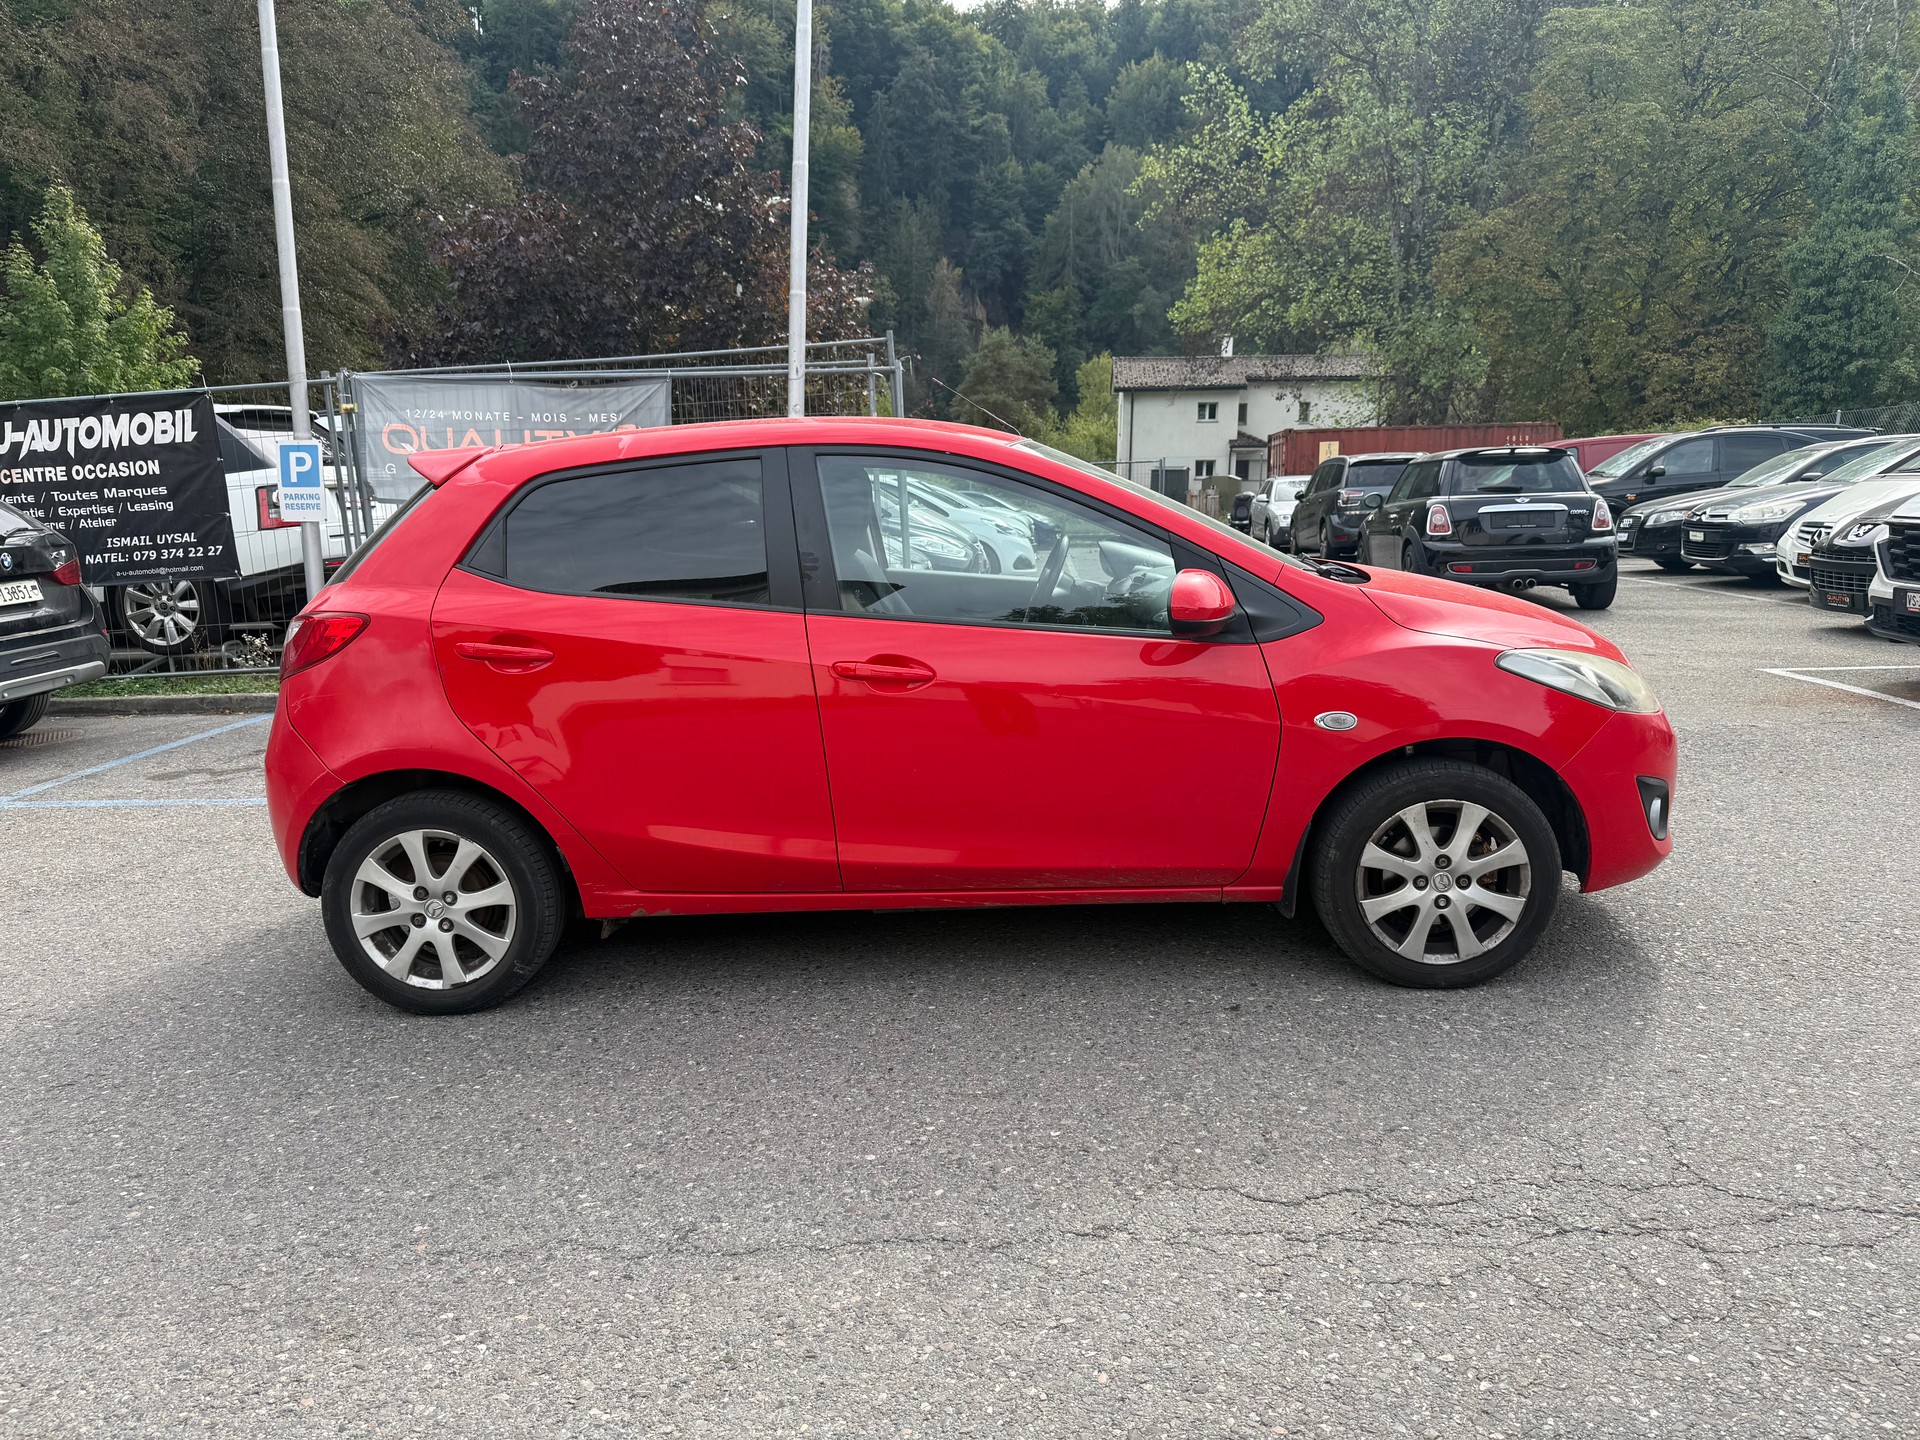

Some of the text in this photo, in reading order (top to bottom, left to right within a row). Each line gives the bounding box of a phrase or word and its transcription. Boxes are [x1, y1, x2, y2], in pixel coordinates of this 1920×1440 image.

[405, 408, 444, 419] 12/24
[452, 410, 510, 421] MONATE
[531, 412, 567, 422] MOIS
[0, 460, 160, 484] CENTRE OCCASION
[289, 451, 312, 483] P
[51, 490, 99, 502] Toutes
[103, 486, 168, 499] Marques
[284, 493, 320, 501] PARKING
[58, 504, 114, 518] Expertise
[126, 500, 174, 512] Leasing
[285, 502, 321, 511] RESERVE
[79, 517, 117, 529] Atelier
[106, 532, 197, 548] ISMAIL UYSAL
[85, 545, 223, 565] NATEL: 079 374 22 27
